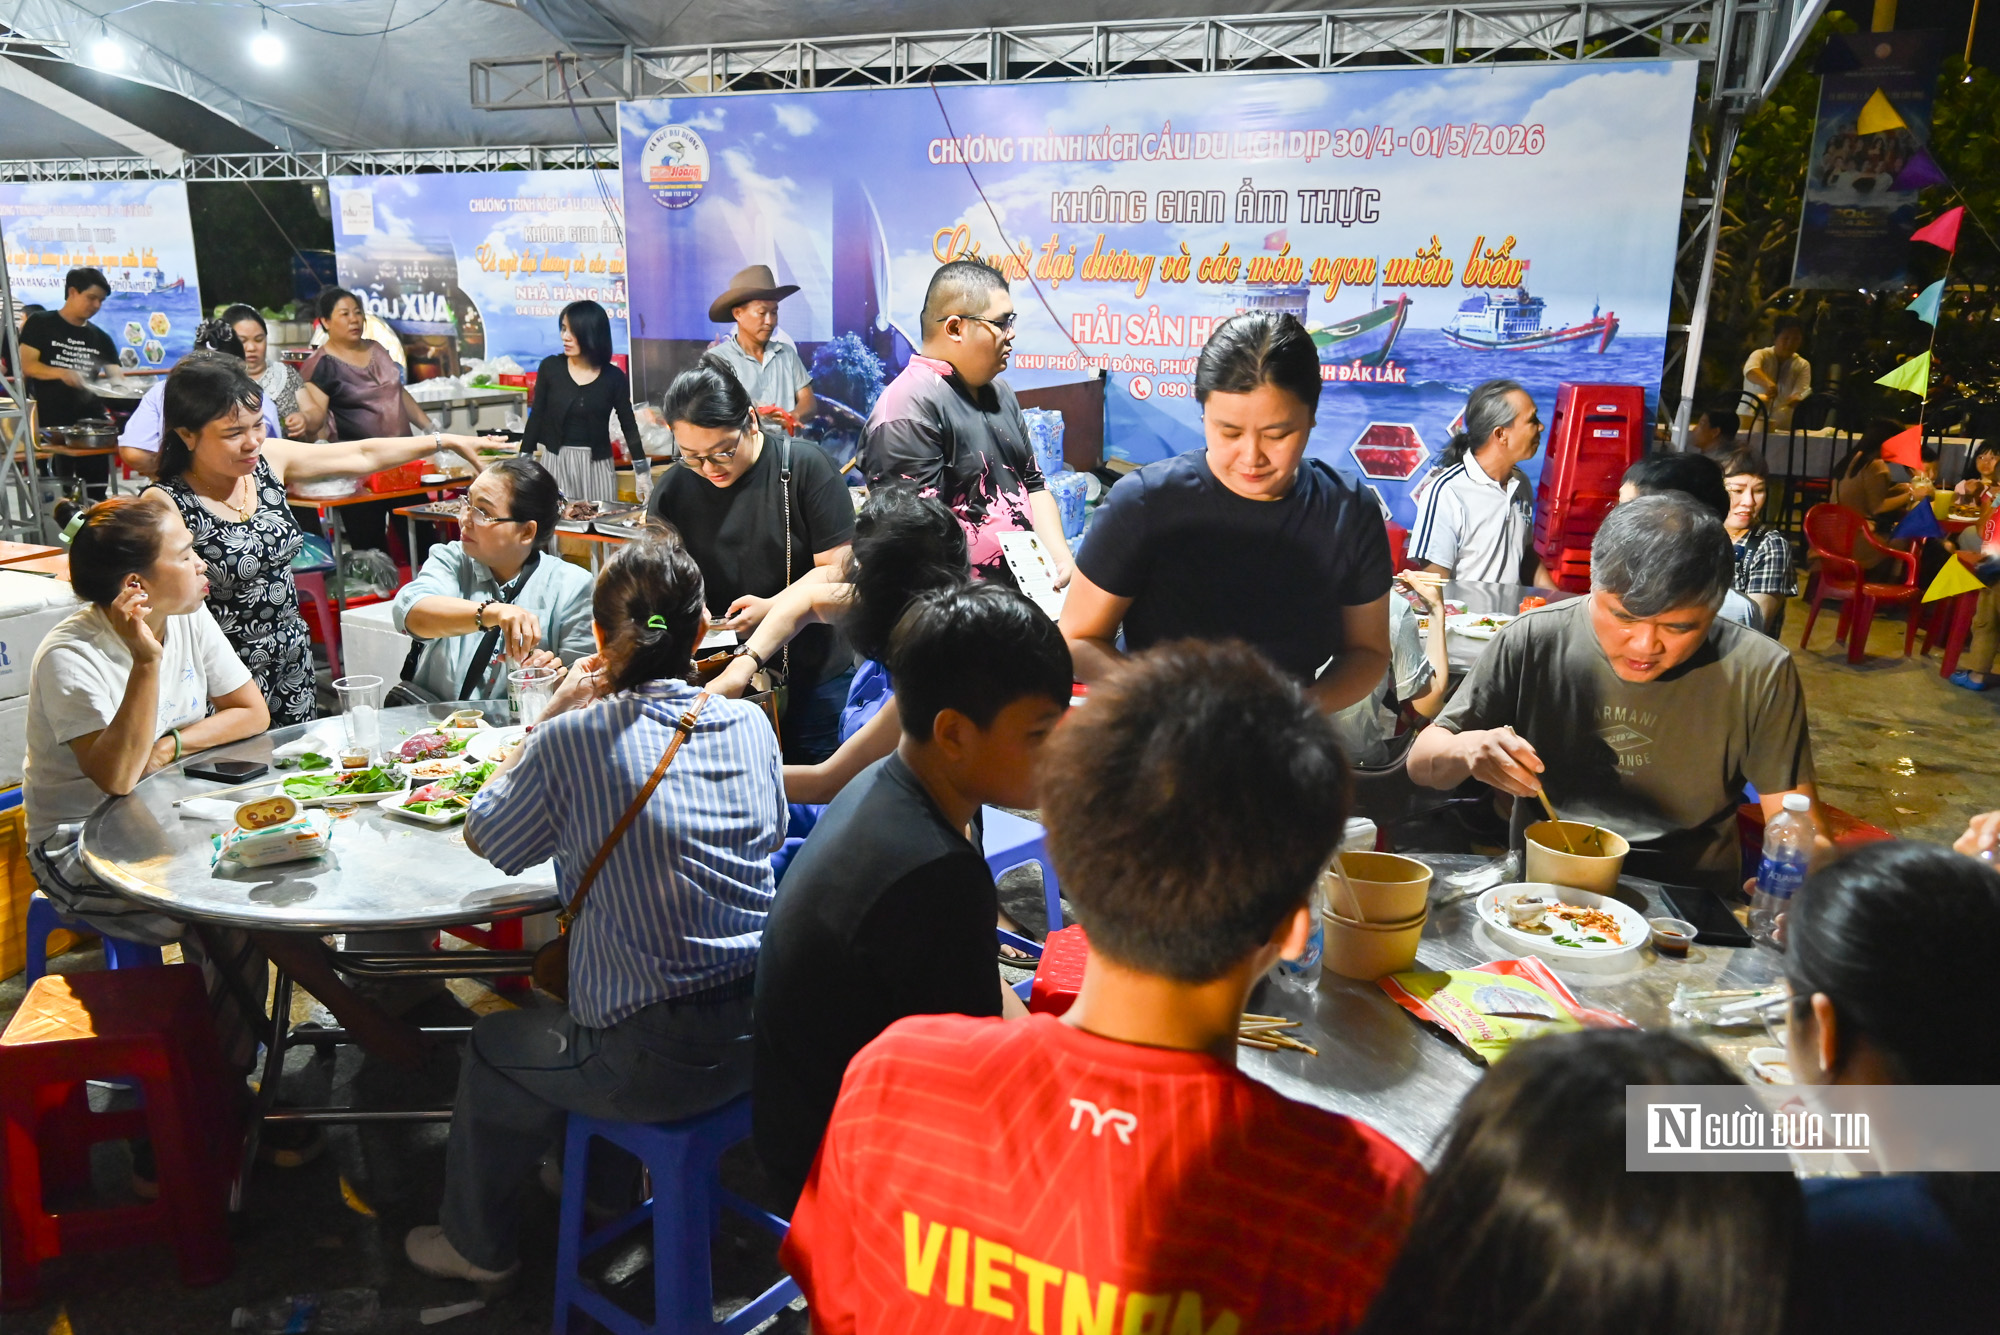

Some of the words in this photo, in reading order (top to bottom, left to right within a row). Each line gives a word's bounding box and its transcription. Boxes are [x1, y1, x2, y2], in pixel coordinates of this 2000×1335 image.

[928, 133, 1014, 164] CHƯƠNG
[1018, 128, 1084, 162] TRÌNH
[1087, 125, 1140, 161] KÍCH
[1142, 120, 1191, 161] CẦU
[1194, 132, 1228, 159] DU
[1231, 129, 1286, 162] LỊCH
[1289, 128, 1331, 163] DỊP
[1333, 125, 1394, 159] 30/4
[1410, 123, 1545, 158] 01/5/2026
[469, 197, 507, 213] CHƯƠNG
[1051, 185, 1147, 223] KHÔNG
[1156, 190, 1226, 224] GIAN
[1235, 177, 1288, 224] ẨM
[1298, 187, 1381, 228] THỰC
[524, 223, 566, 243] KHÔNG
[569, 226, 597, 243] GIAN
[932, 223, 981, 264] C
[1035, 233, 1077, 289] đại
[1080, 233, 1156, 298] dương
[1160, 241, 1191, 283] và
[1197, 241, 1241, 284] các
[1246, 241, 1303, 286] món
[1309, 253, 1377, 303] ngon
[1383, 234, 1453, 288] miền
[1461, 234, 1524, 288] biển
[515, 282, 549, 300] NHÀ
[553, 283, 598, 301] HÀNG
[602, 281, 626, 302] NẪ
[1072, 304, 1121, 344] HẢI
[1125, 305, 1185, 347] SẢN
[1014, 354, 1044, 369] KHU
[1048, 351, 1078, 370] PHỐ
[1079, 353, 1110, 371] PHÚ
[1111, 354, 1158, 377] ĐÔNG,
[1339, 359, 1373, 382] ĐẮK
[1375, 360, 1407, 383] LẮK
[1157, 382, 1188, 398] 090
[1593, 705, 1658, 728] ARMANI
[1069, 1098, 1137, 1145] TYR
